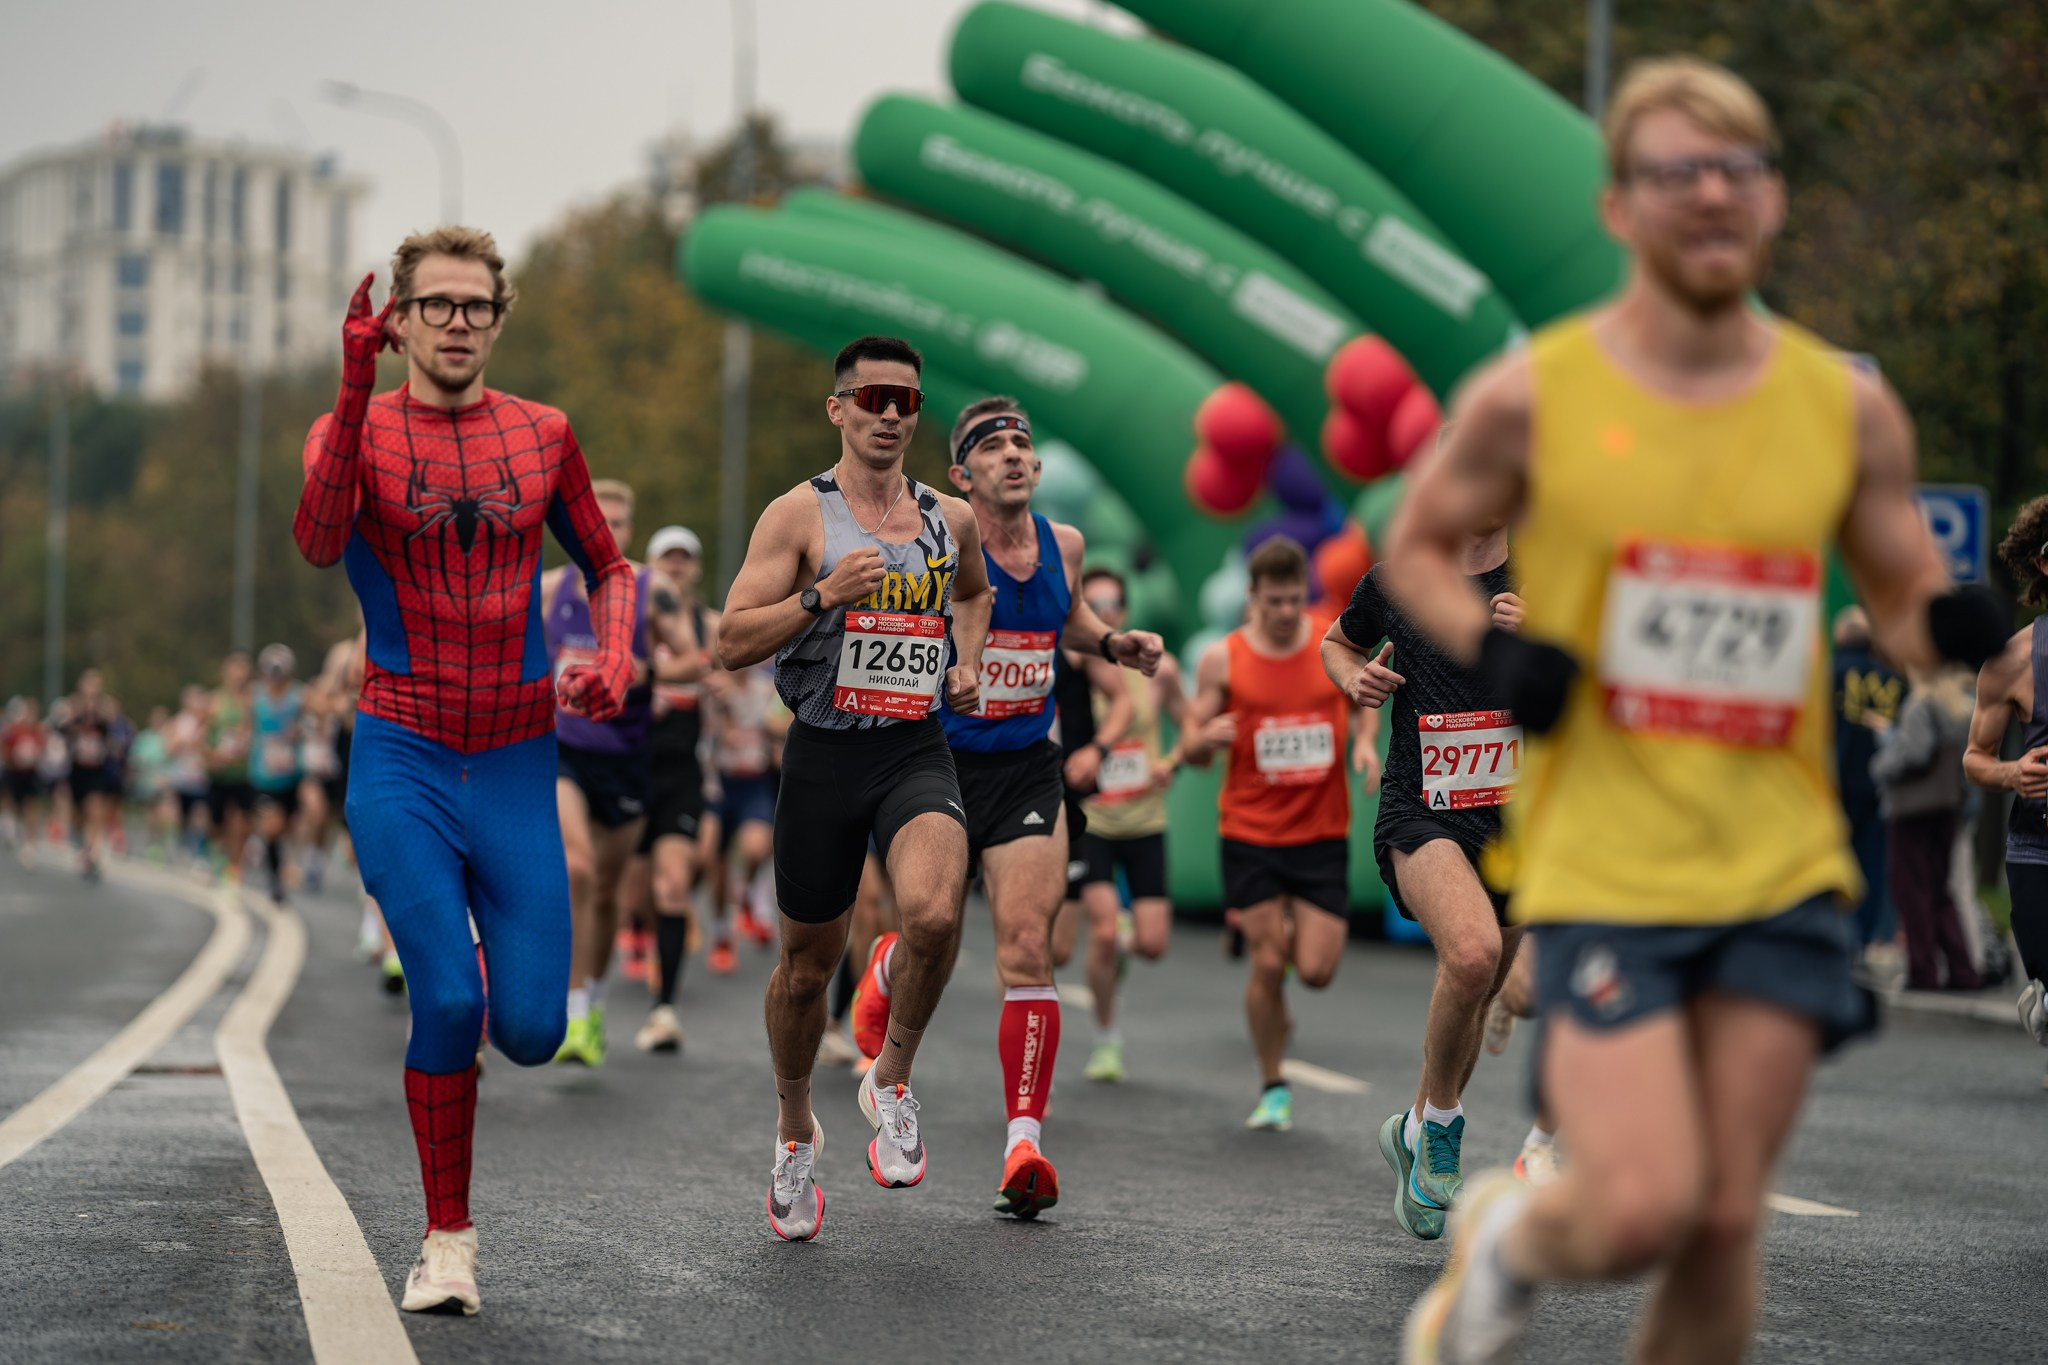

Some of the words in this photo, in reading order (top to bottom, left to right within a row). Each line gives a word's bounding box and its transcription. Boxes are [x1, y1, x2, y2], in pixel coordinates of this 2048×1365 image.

[1638, 595, 1792, 666] 4729
[849, 639, 940, 676] 12658
[868, 675, 919, 688] НИКОЛАЙ
[979, 661, 1050, 689] 9007
[1445, 716, 1486, 724] МОСКОВСКИЙ
[1422, 739, 1519, 776] 29771
